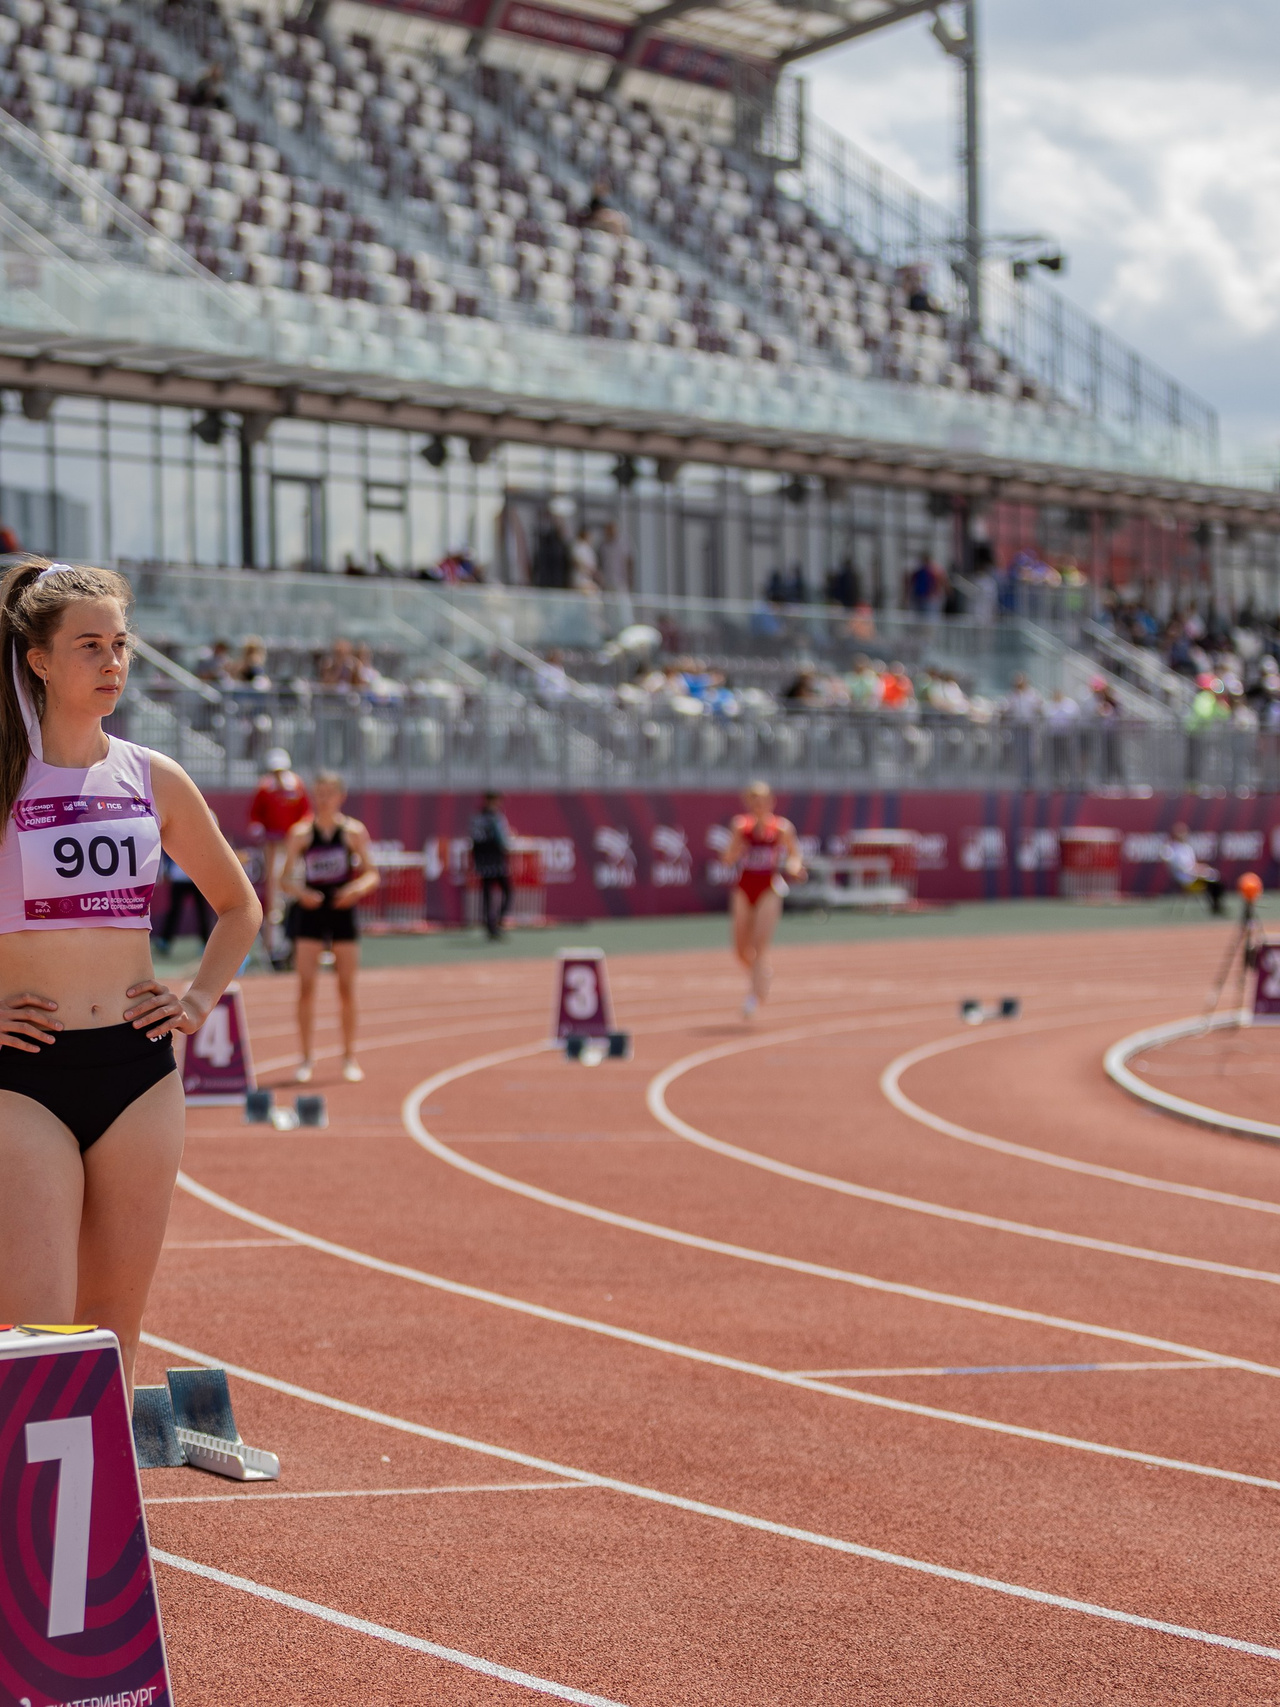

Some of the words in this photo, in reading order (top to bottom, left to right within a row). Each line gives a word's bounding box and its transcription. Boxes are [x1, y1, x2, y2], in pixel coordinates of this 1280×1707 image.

[25, 815, 57, 826] FONBET
[53, 835, 137, 879] 901
[80, 897, 110, 911] U23
[565, 965, 599, 1019] 3
[194, 1003, 234, 1068] 4
[25, 1415, 94, 1638] 7
